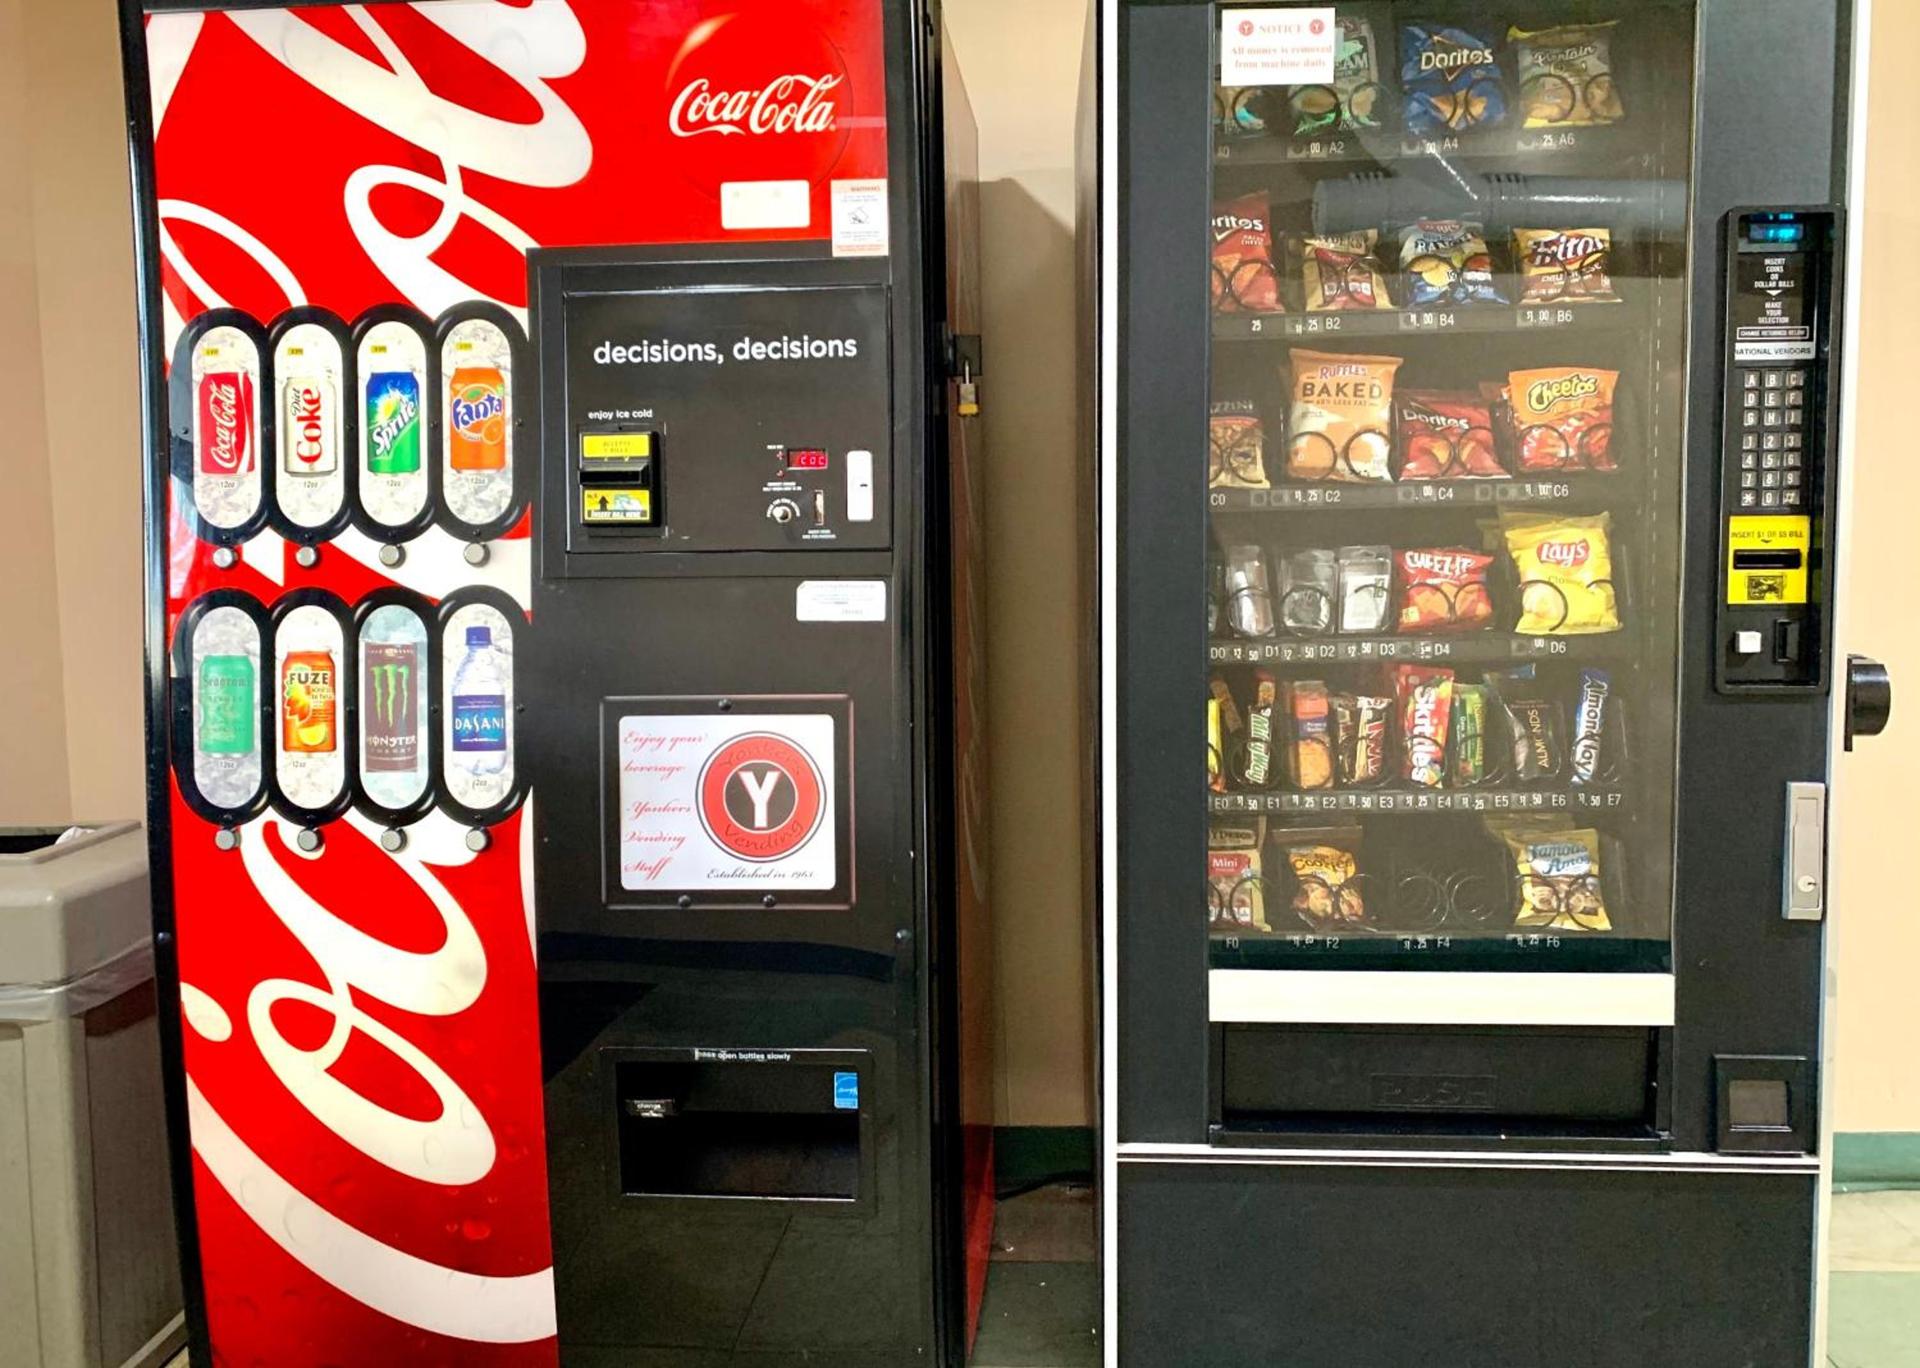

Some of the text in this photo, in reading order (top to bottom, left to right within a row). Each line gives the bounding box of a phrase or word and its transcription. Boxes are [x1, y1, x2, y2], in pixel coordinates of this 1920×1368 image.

[1259, 24, 1301, 33] NOTICE
[1421, 48, 1493, 70] Doritos
[669, 74, 843, 137] Coca-Cola
[1443, 139, 1459, 150] A4
[1559, 134, 1575, 146] A6
[1329, 141, 1344, 154] A2
[1439, 314, 1454, 326] B4
[1557, 310, 1573, 322] B6
[1325, 317, 1341, 329] B2
[593, 335, 857, 365] decisions, decisions
[1747, 374, 1797, 385] A B C
[1302, 382, 1383, 399] BAKED
[1529, 378, 1597, 411] Cheetos
[1749, 393, 1796, 404] D E F
[588, 409, 653, 420] enjoy ice cold
[1403, 410, 1469, 429] Doritos
[1747, 411, 1795, 422] G H J
[296, 388, 323, 463] Coke
[372, 400, 416, 455] Sprite
[1747, 435, 1795, 446] 1 2 3
[1746, 454, 1794, 465] 4 5 6
[1746, 472, 1794, 484] 7 8 9
[1325, 490, 1341, 503] C2
[1438, 487, 1454, 501] C4
[1553, 484, 1569, 497] C6
[1765, 493, 1772, 503] 0
[1210, 647, 1226, 659] D0
[1265, 645, 1279, 657] D1
[1320, 646, 1335, 657] D2
[1380, 643, 1395, 656] D3
[1434, 644, 1450, 655] D4
[1551, 641, 1567, 653] D6
[289, 672, 329, 685] FUZE
[455, 714, 504, 732] DASANI
[624, 731, 666, 753] Enjoy
[1527, 709, 1550, 768] ALMNDS
[624, 760, 686, 781] beverage
[738, 770, 781, 828] Y
[1267, 798, 1280, 808] E1
[1323, 798, 1336, 808] E2
[1380, 798, 1394, 808] E3
[1438, 797, 1451, 808] E4
[1495, 796, 1509, 807] E5
[1552, 794, 1566, 806] E6
[1608, 794, 1621, 805] E7
[725, 821, 803, 850] Vending
[624, 856, 672, 881] Staff
[1212, 858, 1238, 868] Mini
[707, 867, 774, 879] Established
[1226, 937, 1239, 948] F0
[1326, 937, 1339, 949] F2
[1437, 937, 1450, 948] F4
[1547, 936, 1560, 948] F6
[717, 1052, 791, 1061] open bottles slowly
